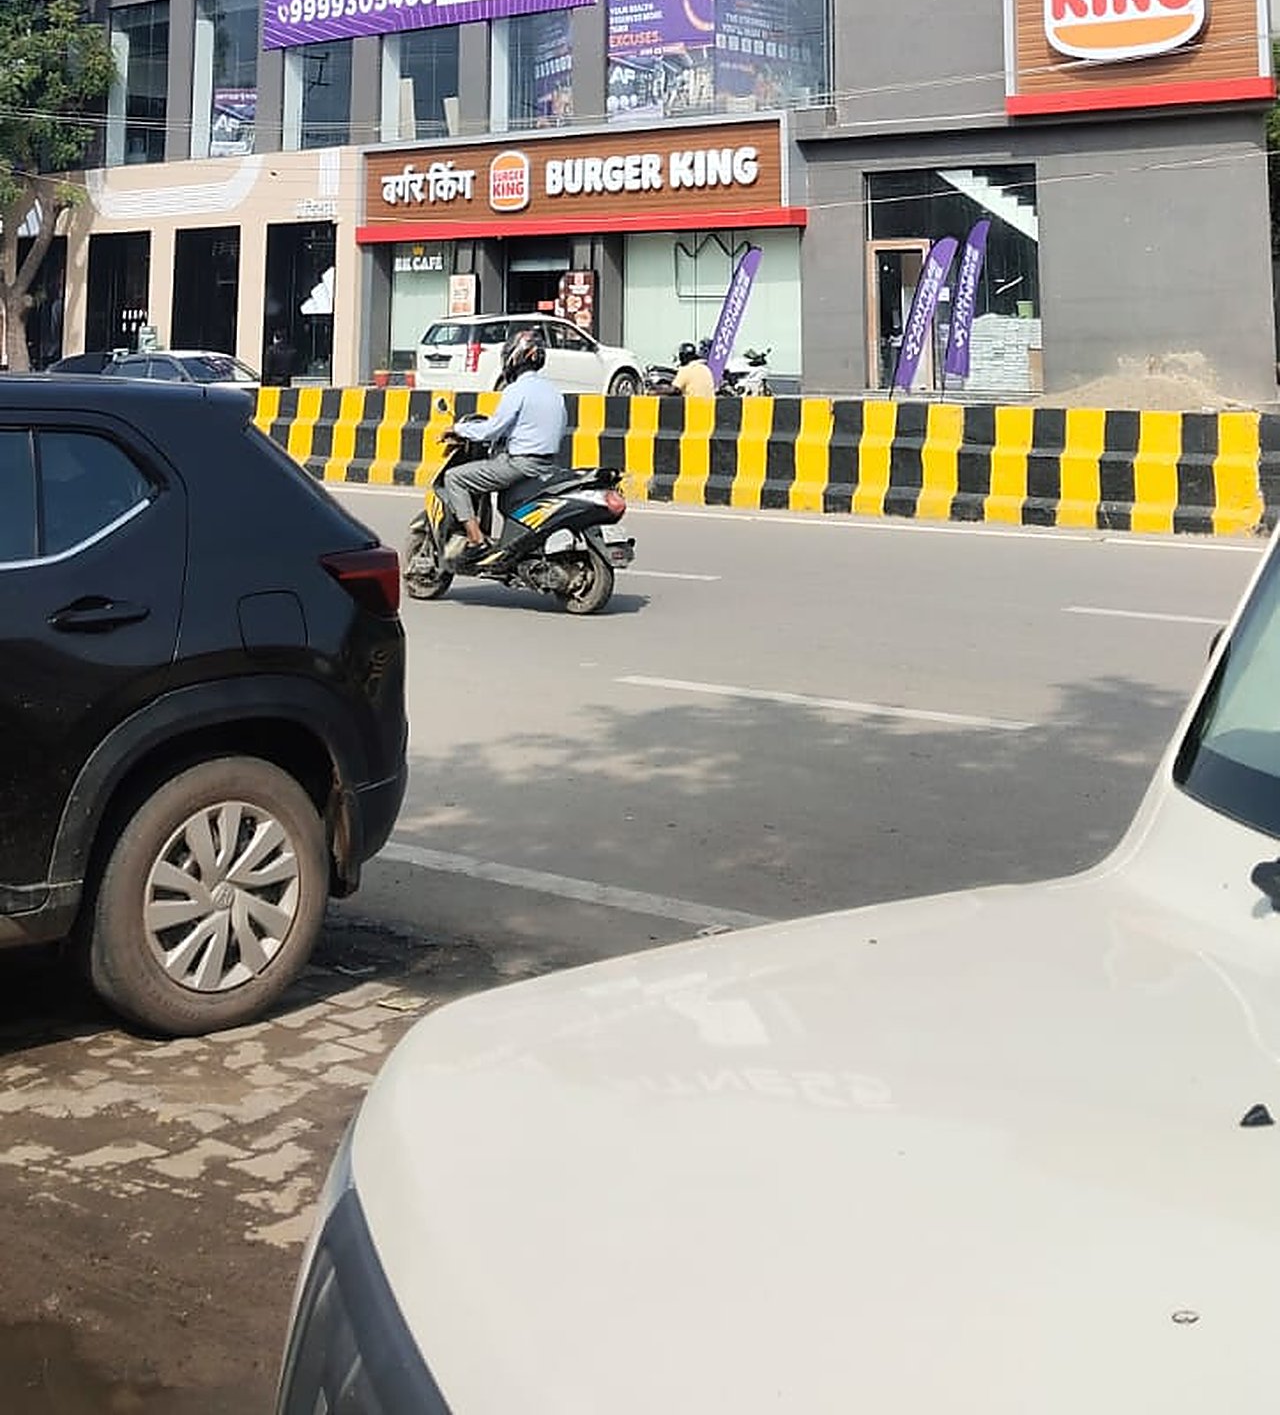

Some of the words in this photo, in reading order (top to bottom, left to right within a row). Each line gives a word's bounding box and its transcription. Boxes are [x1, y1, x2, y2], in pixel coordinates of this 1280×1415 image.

[381, 164, 425, 204] बर्गर
[426, 160, 475, 202] किंग
[493, 169, 524, 182] BURGER
[546, 154, 663, 195] BURGER
[669, 147, 758, 188] KING
[493, 182, 524, 196] KING
